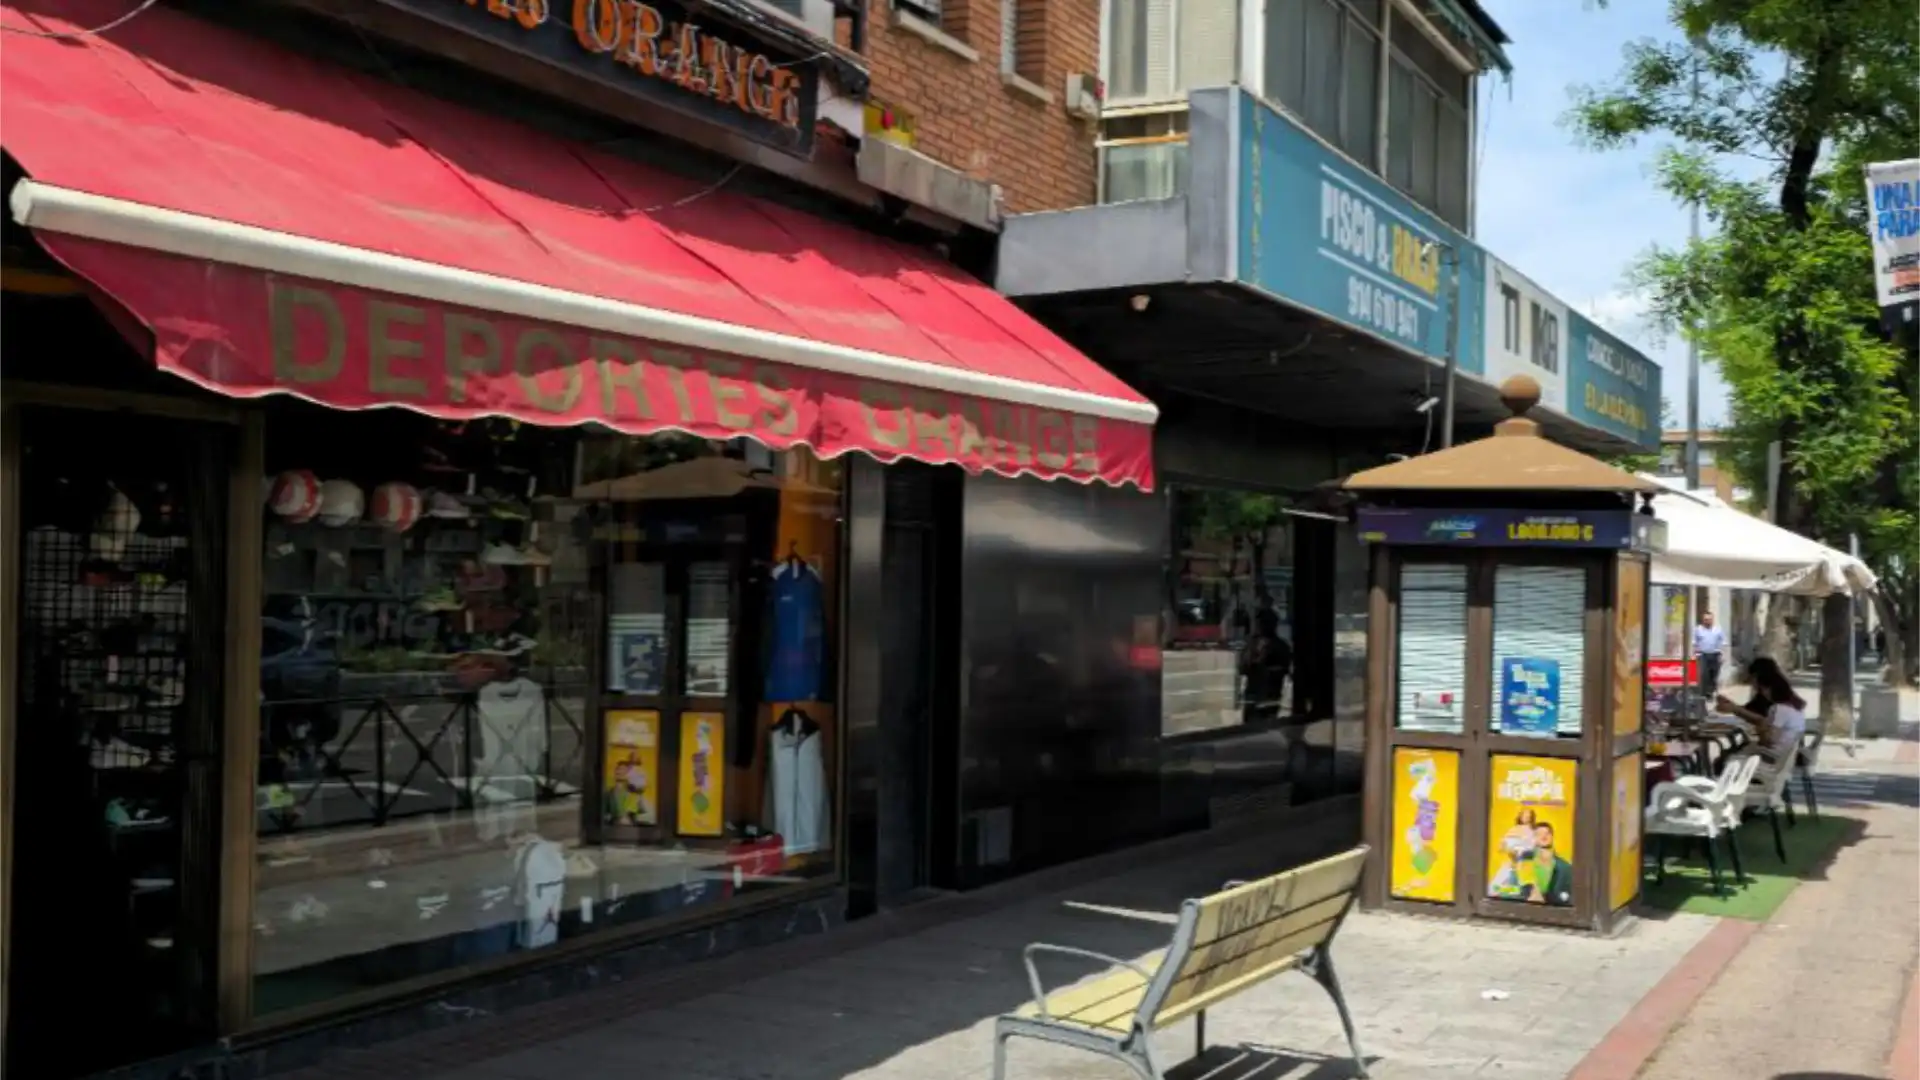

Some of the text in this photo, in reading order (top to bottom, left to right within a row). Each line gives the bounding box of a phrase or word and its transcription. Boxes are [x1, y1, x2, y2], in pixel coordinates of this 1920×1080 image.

[571, 0, 801, 127] ORANGE
[1321, 180, 1375, 263] PISCO
[1377, 223, 1391, 273] &
[1373, 288, 1396, 332] 610
[270, 284, 798, 438] DEPORTES
[858, 381, 1100, 472] ORANGE
